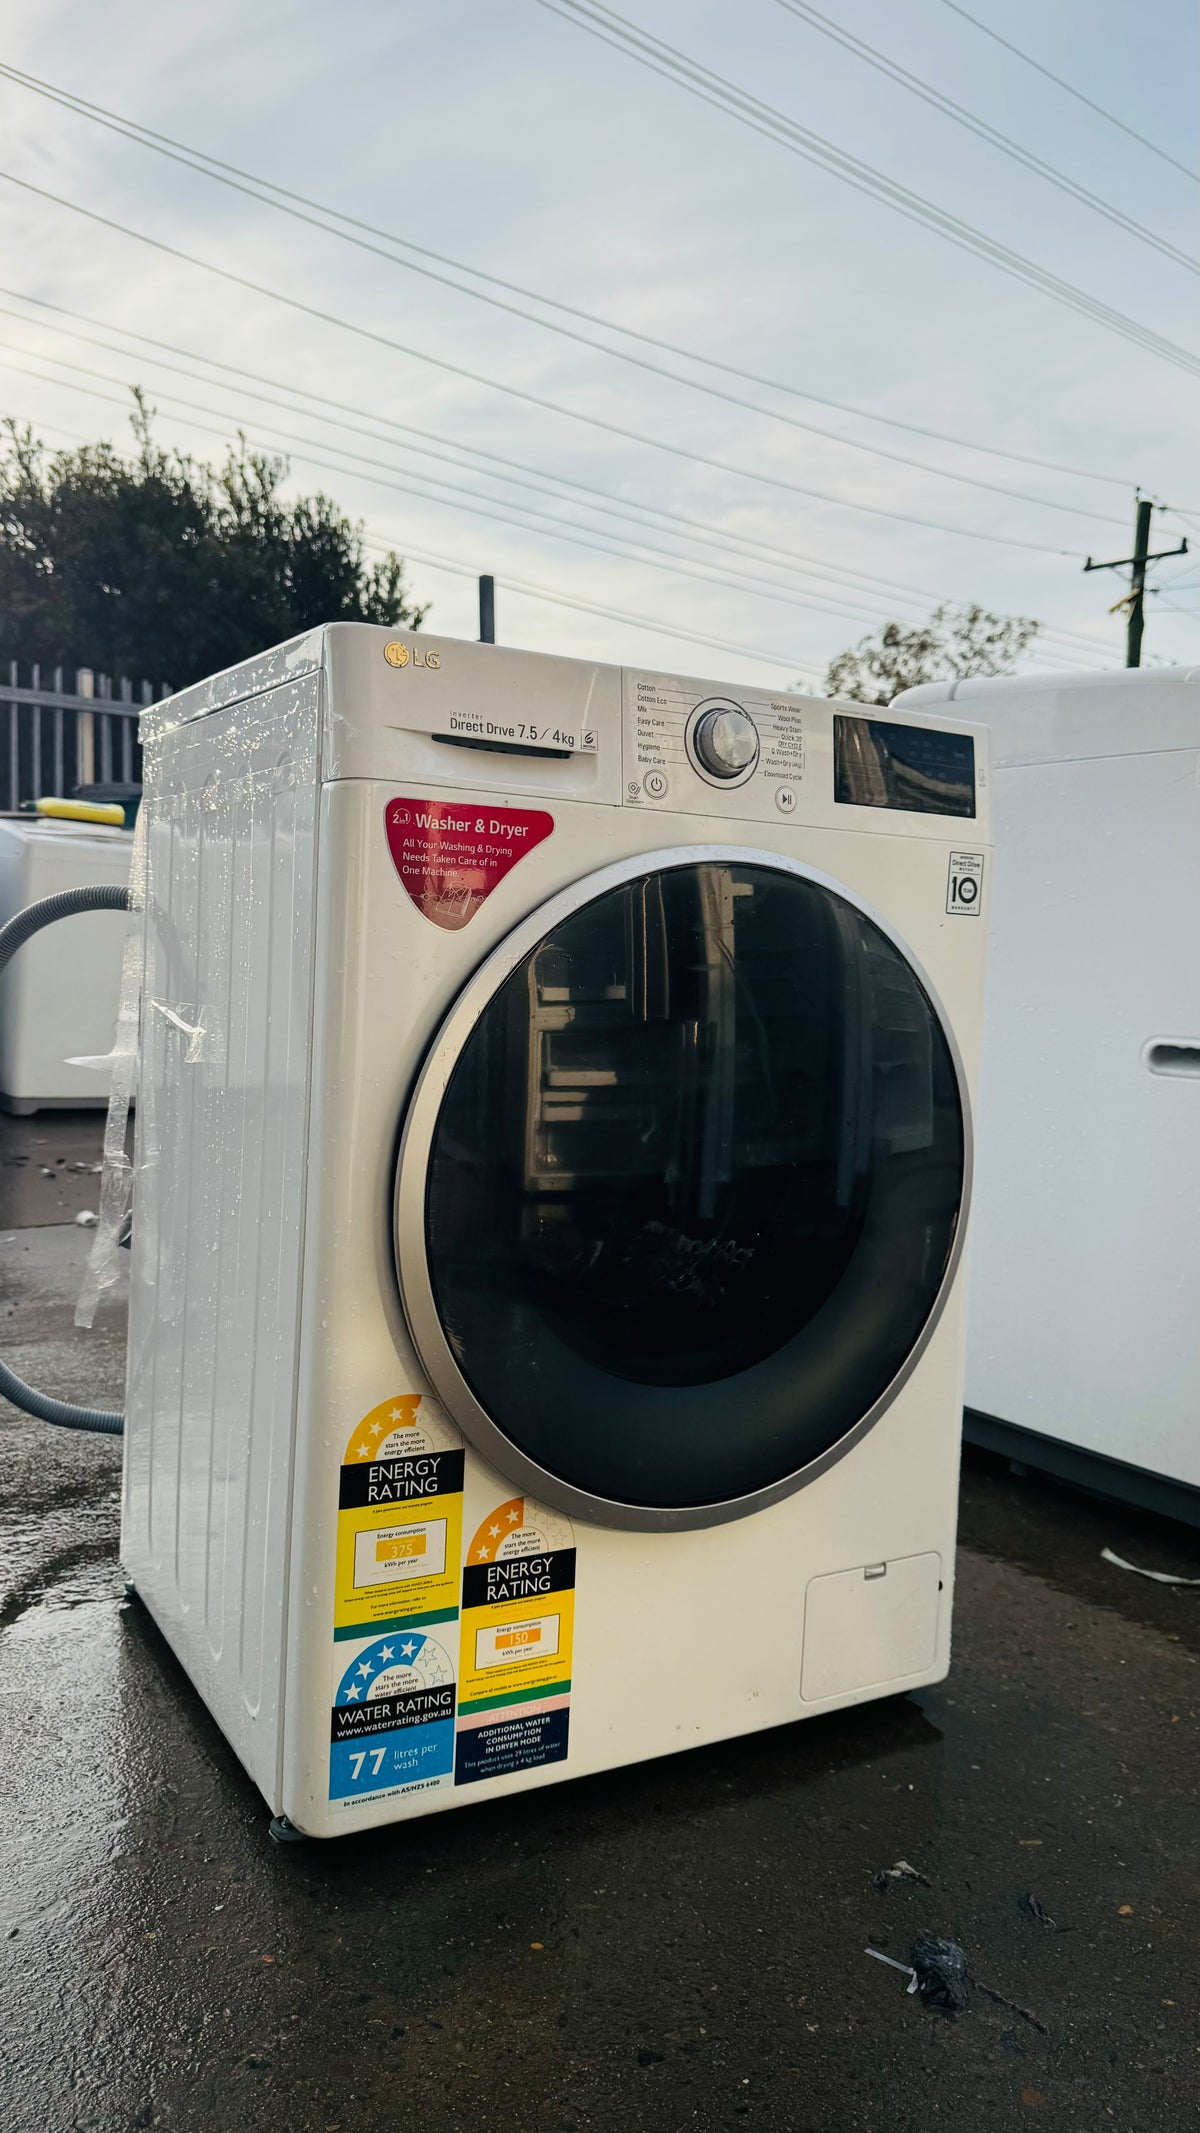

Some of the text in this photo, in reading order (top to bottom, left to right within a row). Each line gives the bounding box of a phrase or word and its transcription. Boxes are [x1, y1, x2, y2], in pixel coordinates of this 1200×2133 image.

[413, 648, 441, 669] LG
[637, 684, 656, 692] Cotton
[637, 694, 656, 702] Cotton
[771, 703, 787, 711] Sports
[450, 711, 484, 720] inverter
[638, 717, 650, 726] Easy
[450, 718, 484, 734] Direct
[486, 722, 514, 737] Drive
[518, 724, 538, 740] 7.5
[552, 730, 575, 747] 4kg
[638, 729, 654, 737] Duvet
[773, 724, 788, 732] Heavy
[638, 742, 660, 751] Hygiene
[638, 755, 652, 764] Baby
[764, 770, 788, 779] Download
[416, 813, 471, 832] Washer
[475, 819, 485, 833] &
[490, 820, 528, 839] Dryer
[403, 838, 512, 857] All Your Washing & Drying
[403, 852, 497, 867] Needs Taken Care of in
[402, 866, 420, 875] One
[952, 876, 978, 904] 10
[369, 1457, 441, 1483] ENERGY
[368, 1477, 438, 1502] RATING
[395, 1527, 426, 1536] consumption
[391, 1543, 413, 1558] 375
[487, 1556, 553, 1583] ENERGY
[487, 1576, 551, 1601] RATING
[513, 1620, 541, 1629] consumption
[510, 1631, 528, 1646] 150
[402, 1678, 418, 1686] more
[394, 1686, 417, 1695] efficient
[338, 1691, 452, 1726] WATER RATING
[337, 1708, 452, 1738] www.waterrating.gov.au
[478, 1717, 551, 1739] ADDITIONAL WATER
[486, 1727, 542, 1745] CONSUMPTION
[394, 1744, 438, 1759] litres per
[495, 1742, 519, 1752] DRYER
[520, 1736, 541, 1746] MODE
[349, 1747, 387, 1780] 77
[393, 1760, 418, 1770] wash
[477, 1756, 500, 1767] product
[497, 1761, 514, 1770] drying
[351, 1794, 386, 1805] accordance
[401, 1784, 425, 1793] AS/NZS
